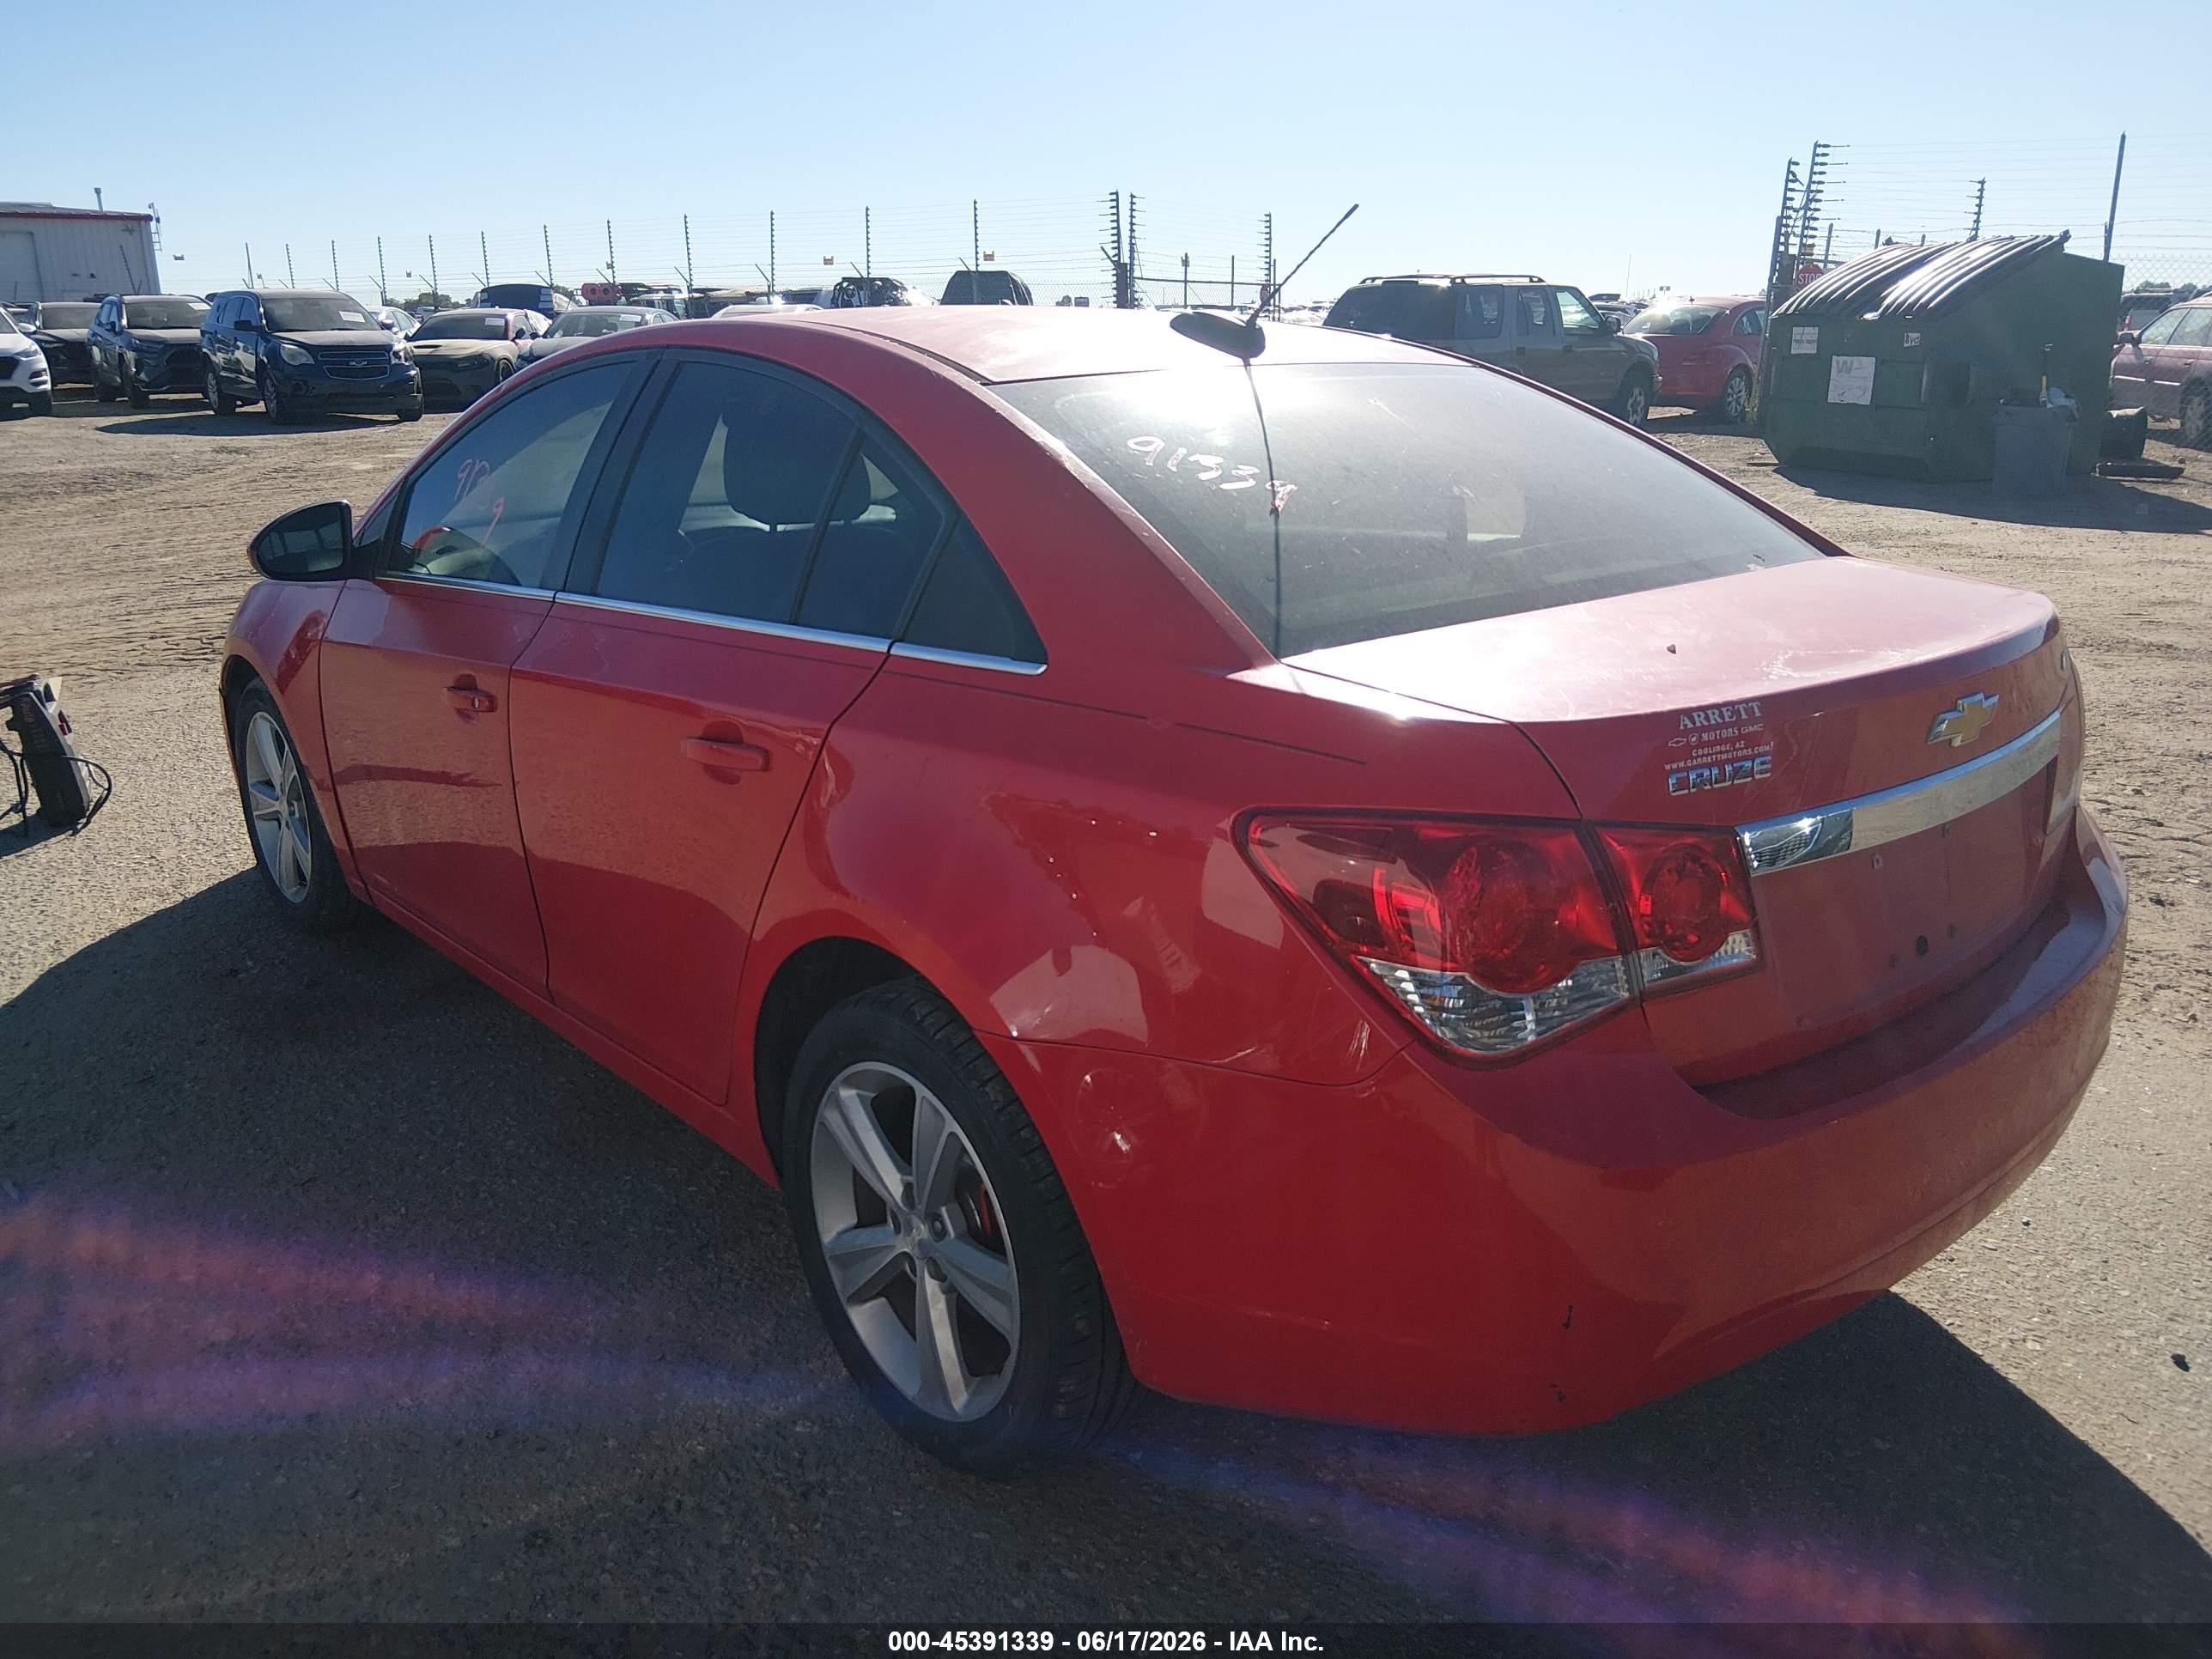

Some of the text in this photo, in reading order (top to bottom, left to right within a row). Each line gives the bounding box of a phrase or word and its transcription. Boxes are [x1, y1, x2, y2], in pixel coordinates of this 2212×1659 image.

[1679, 702, 1763, 730] ARRETT
[1701, 723, 1765, 742] MOTORS GMC
[1668, 756, 1772, 796] CRUZE
